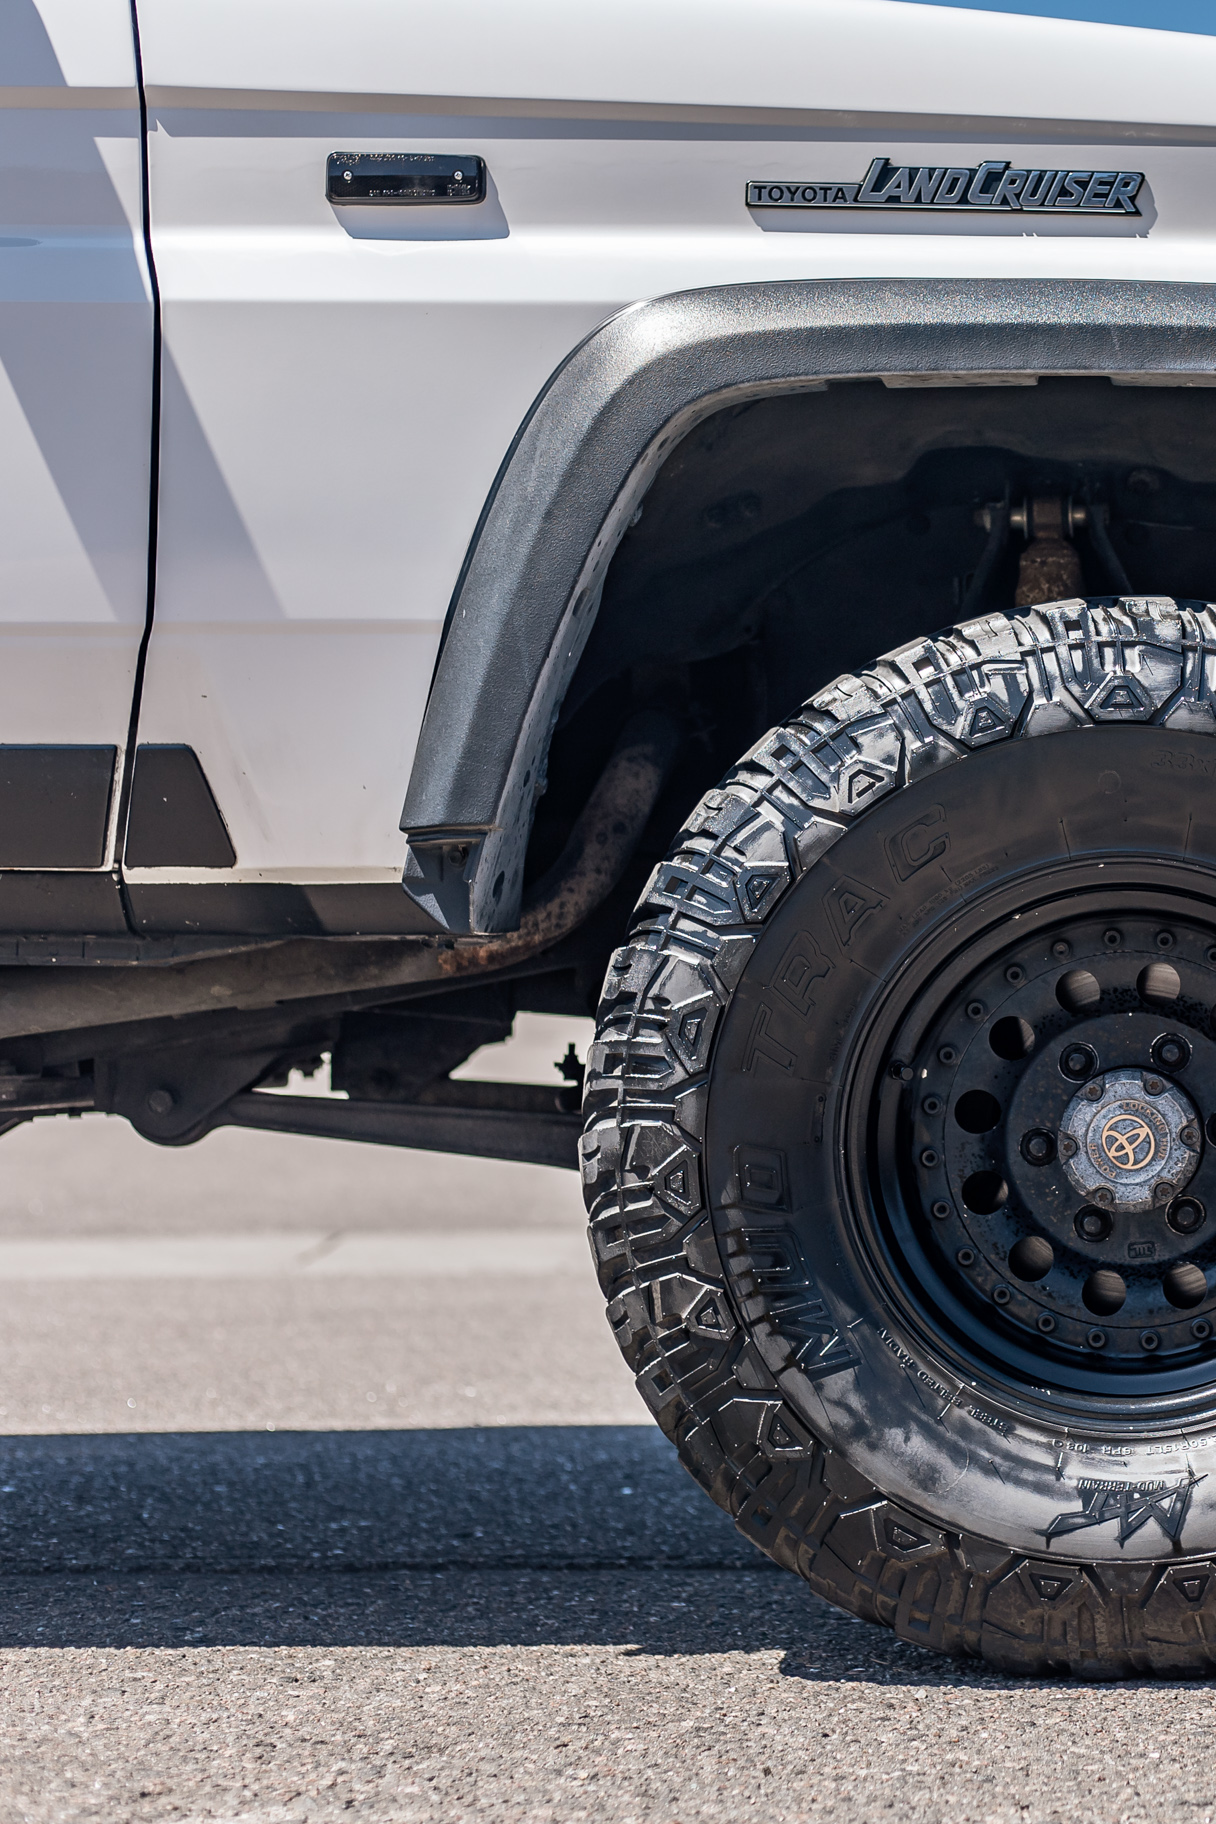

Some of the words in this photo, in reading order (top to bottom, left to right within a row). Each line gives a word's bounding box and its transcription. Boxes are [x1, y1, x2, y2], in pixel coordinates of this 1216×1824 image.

[753, 184, 849, 204] TOYOTA
[742, 802, 951, 1077] TRAC
[1086, 1142, 1117, 1180] POWER
[1121, 1100, 1168, 1134] LOCKING
[1155, 1137, 1169, 1162] HUB
[732, 1143, 863, 1381] MUD
[913, 1366, 964, 1409] BELTED
[964, 1403, 1010, 1434] STEEL
[1077, 1478, 1164, 1494] MUD-TERRAIN
